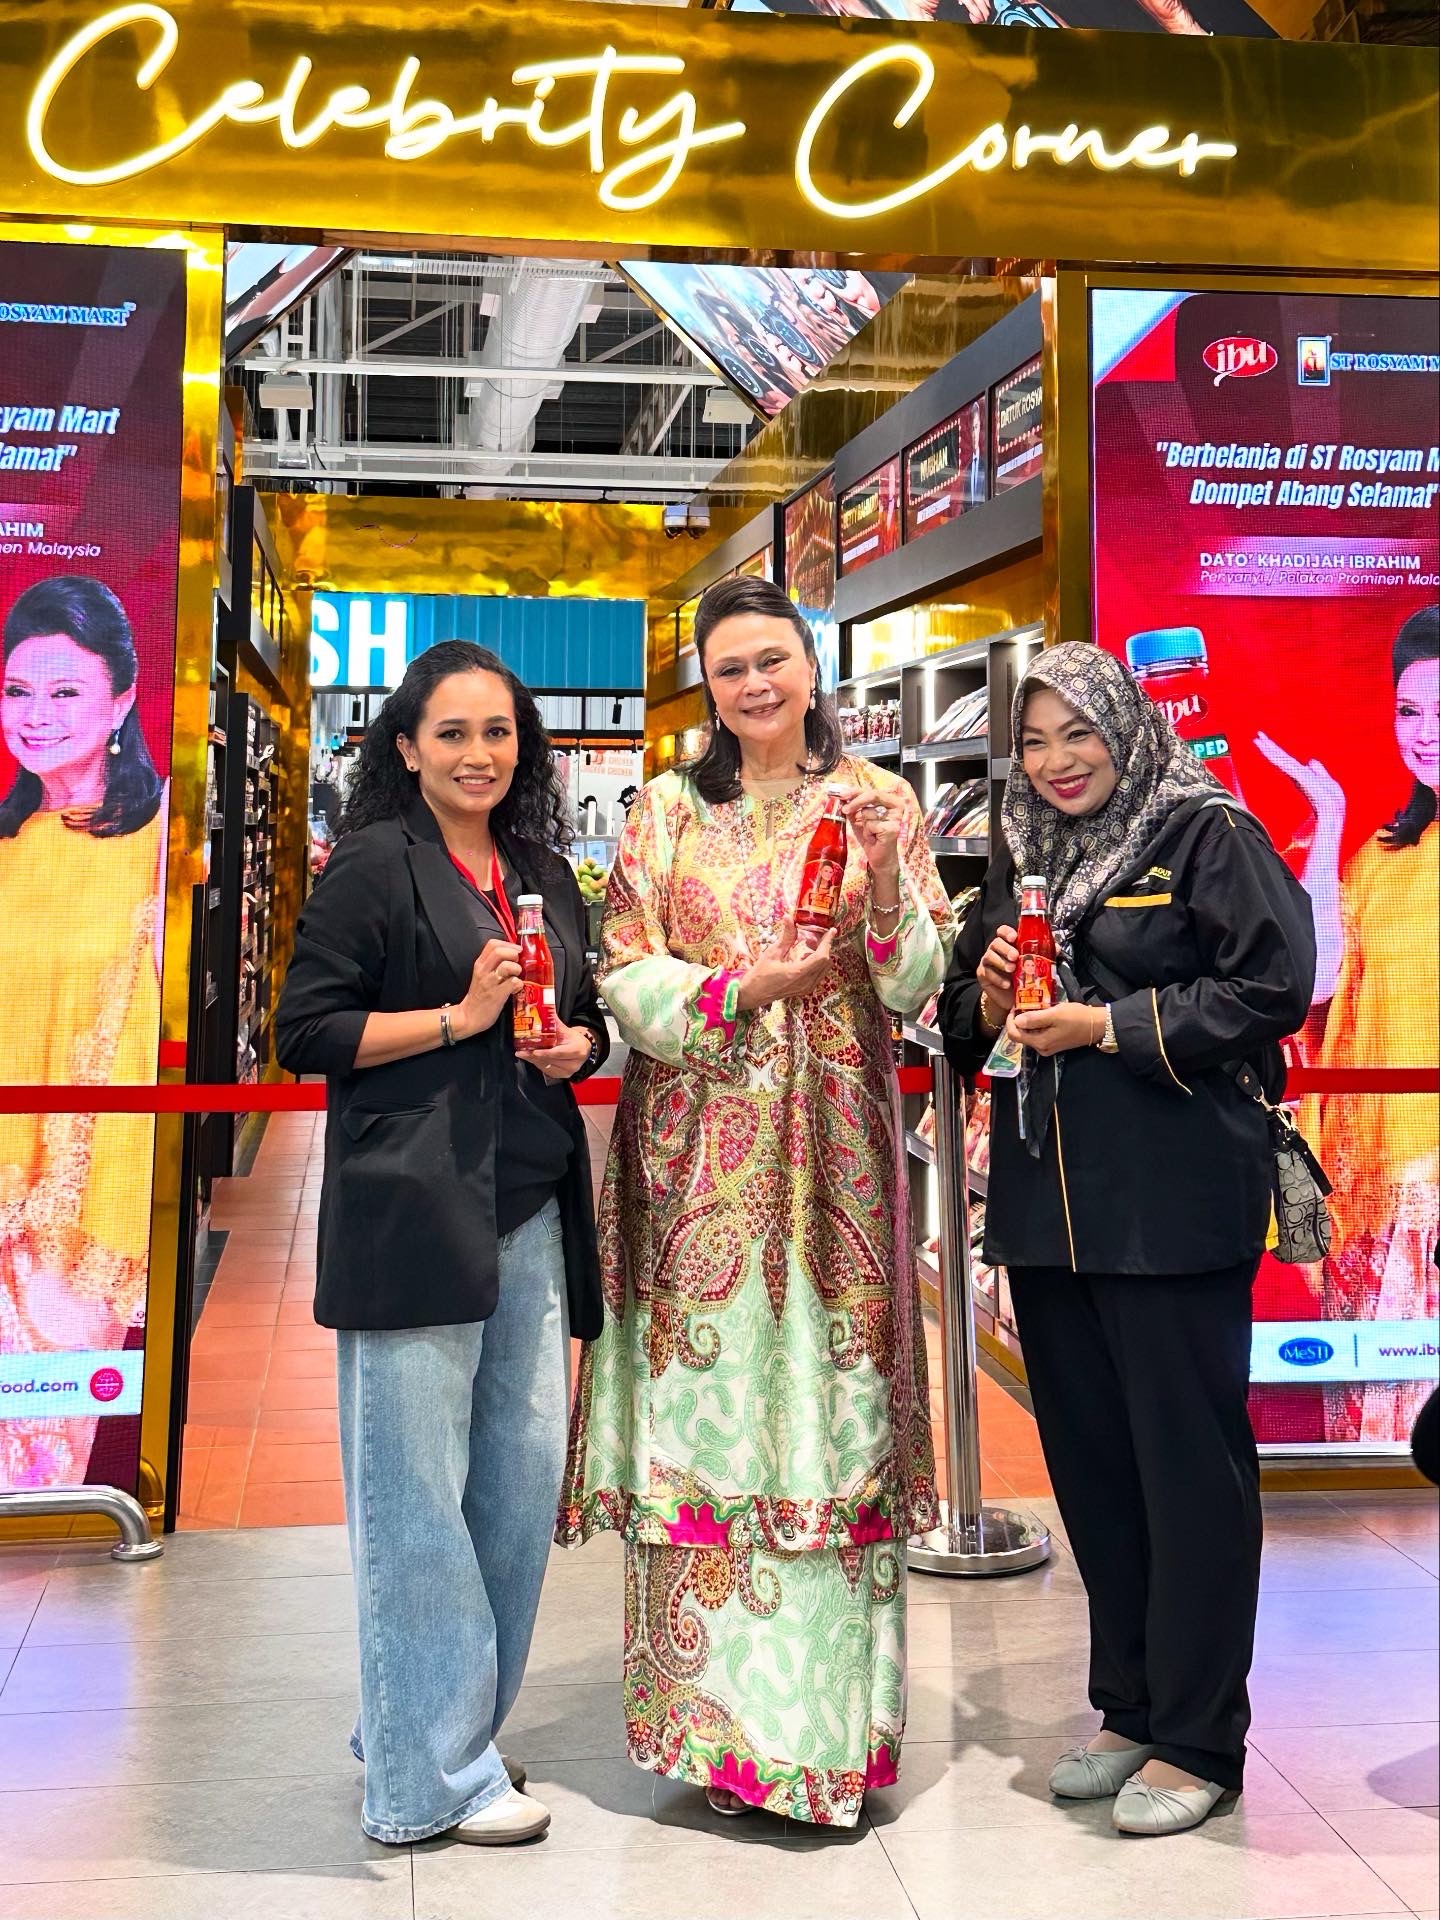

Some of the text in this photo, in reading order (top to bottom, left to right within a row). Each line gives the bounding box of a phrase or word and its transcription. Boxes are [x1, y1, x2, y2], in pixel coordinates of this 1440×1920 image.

[27, 3, 1237, 219] Celebrity Corner
[68, 306, 128, 326] MART
[1213, 341, 1268, 387] ibu
[1331, 352, 1353, 370] ST
[1354, 353, 1428, 371] ROSYAM
[58, 405, 121, 435] Mart
[1156, 441, 1281, 471] "Berbelanja
[1285, 444, 1308, 469] di
[1310, 445, 1335, 470] ST
[1339, 445, 1424, 474] Rosyam
[1190, 479, 1274, 509] Dompet
[1276, 481, 1344, 510] Abang
[28, 541, 101, 560] Malaysia
[1257, 553, 1345, 568] KHADIJAH
[1349, 555, 1421, 570] IBRAHIM
[1279, 571, 1333, 584] Pelakon
[1338, 572, 1404, 585] Prominen
[310, 599, 408, 687] SH
[1158, 694, 1201, 727] ibu
[0, 1378, 79, 1394] ood.com
